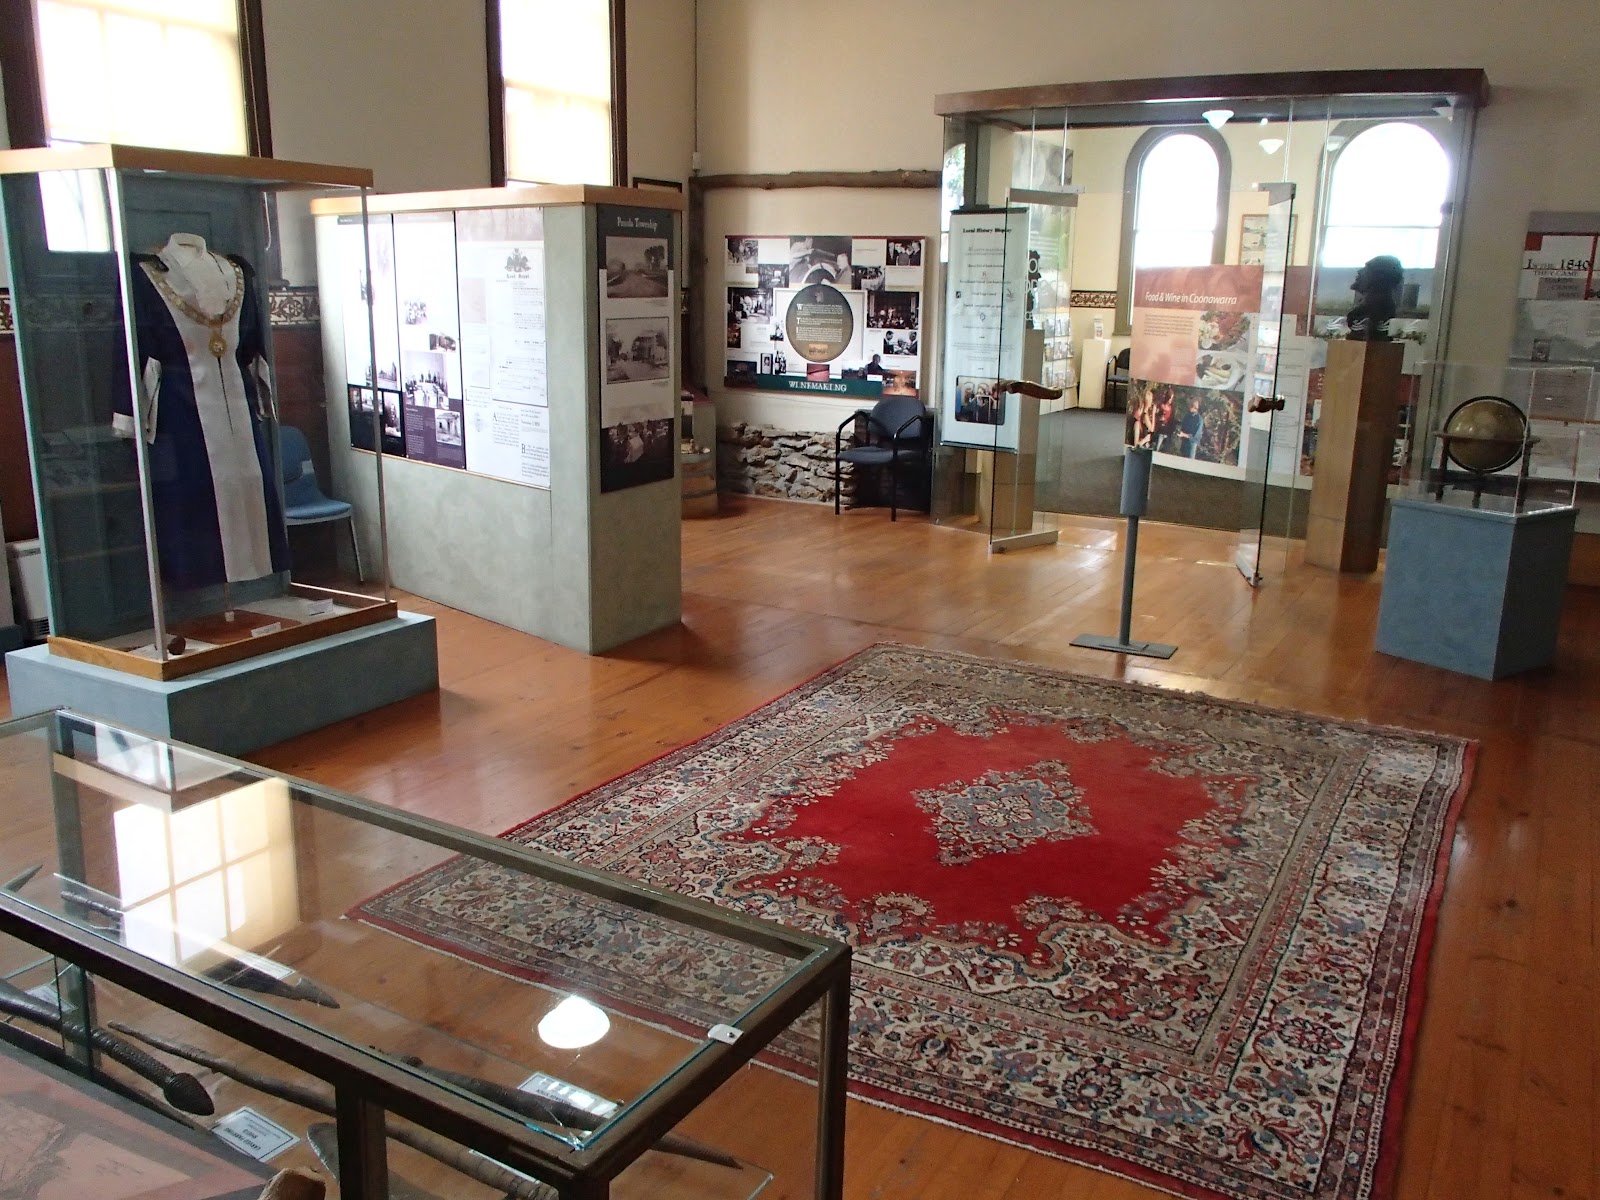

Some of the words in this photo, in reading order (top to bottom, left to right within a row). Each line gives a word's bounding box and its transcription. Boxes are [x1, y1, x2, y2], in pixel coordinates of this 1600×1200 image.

[635, 217, 658, 232] Township
[1145, 291, 1159, 302] Food
[1159, 293, 1165, 302] &
[1165, 293, 1181, 303] Wine
[1181, 293, 1189, 303] in
[1189, 294, 1238, 305] Coonawarra
[788, 380, 847, 393] WINEMAKING
